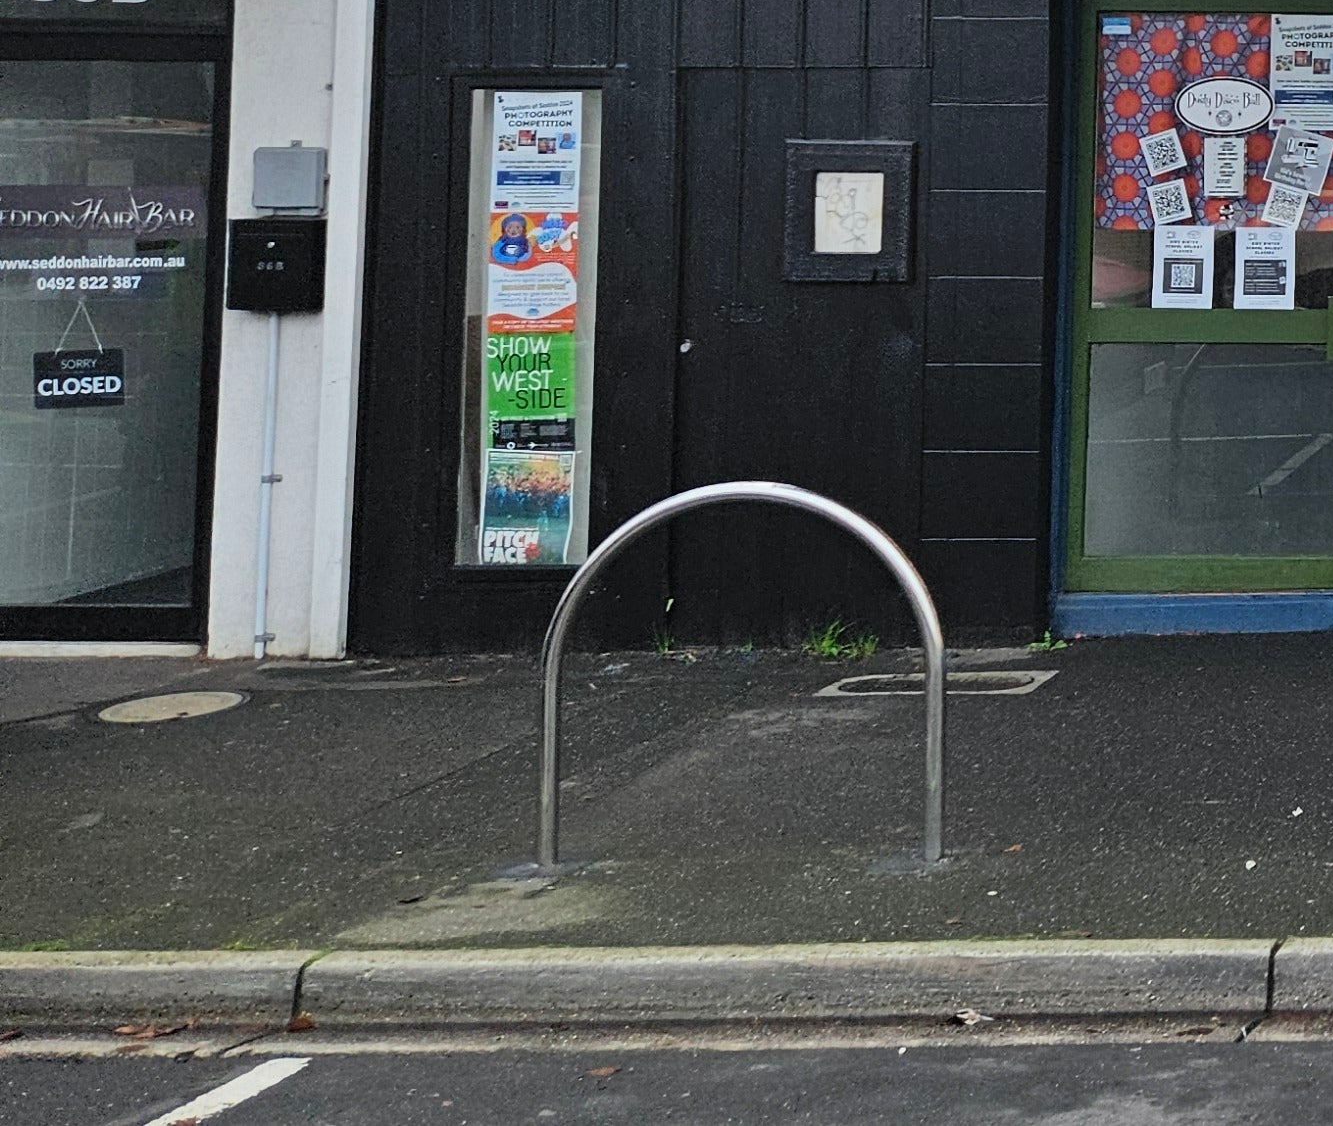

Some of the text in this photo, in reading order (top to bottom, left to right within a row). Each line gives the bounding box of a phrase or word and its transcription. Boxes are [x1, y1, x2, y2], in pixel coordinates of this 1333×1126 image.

[504, 109, 573, 119] PHOTOGRAPHY
[0, 209, 76, 226] EDDON
[136, 200, 196, 232] BAR
[37, 276, 142, 290] 0492 822 387
[487, 337, 552, 358] SHOW
[61, 358, 97, 370] SORRY
[497, 353, 551, 372] YOUR
[37, 375, 122, 397] CLOSED
[492, 369, 553, 392] WEST
[489, 410, 500, 435] 2024
[484, 530, 540, 548] PITCH
[483, 547, 528, 563] FACE
